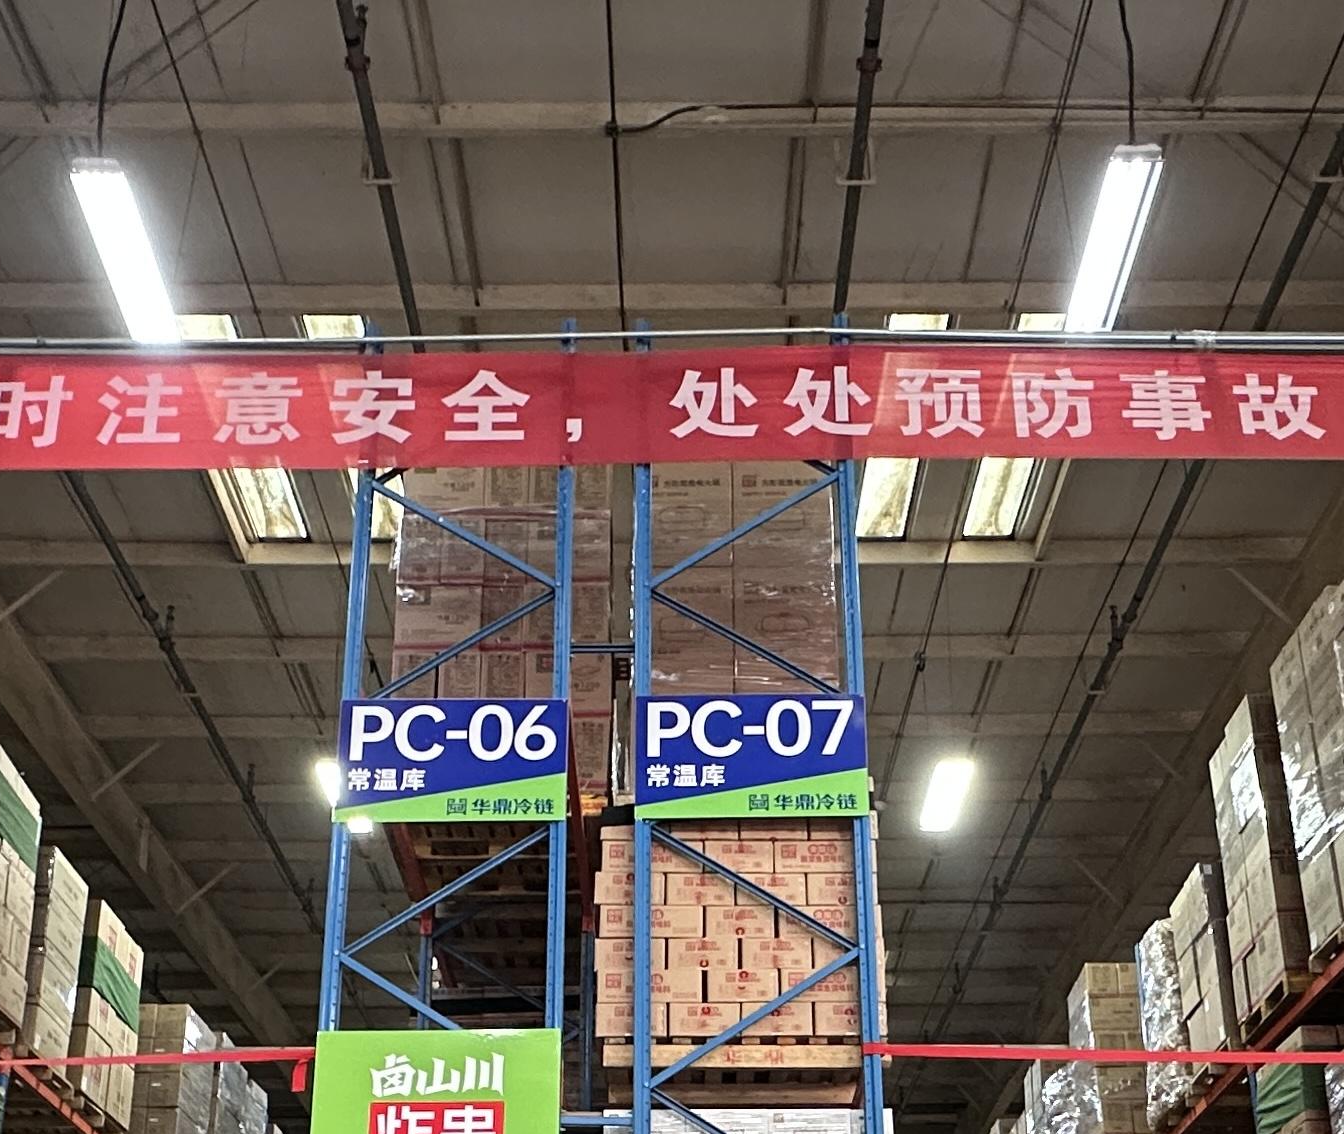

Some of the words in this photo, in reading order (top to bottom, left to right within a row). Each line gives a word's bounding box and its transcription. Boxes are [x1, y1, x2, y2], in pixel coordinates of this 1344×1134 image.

[348, 704, 557, 763] PC-06
[646, 699, 855, 757] PC-07
[347, 767, 426, 791] 常温库
[646, 763, 726, 788] 常温库
[470, 798, 555, 816] 华鼎冷链
[774, 793, 859, 812] 华鼎冷链
[370, 1053, 505, 1098] 卤山川
